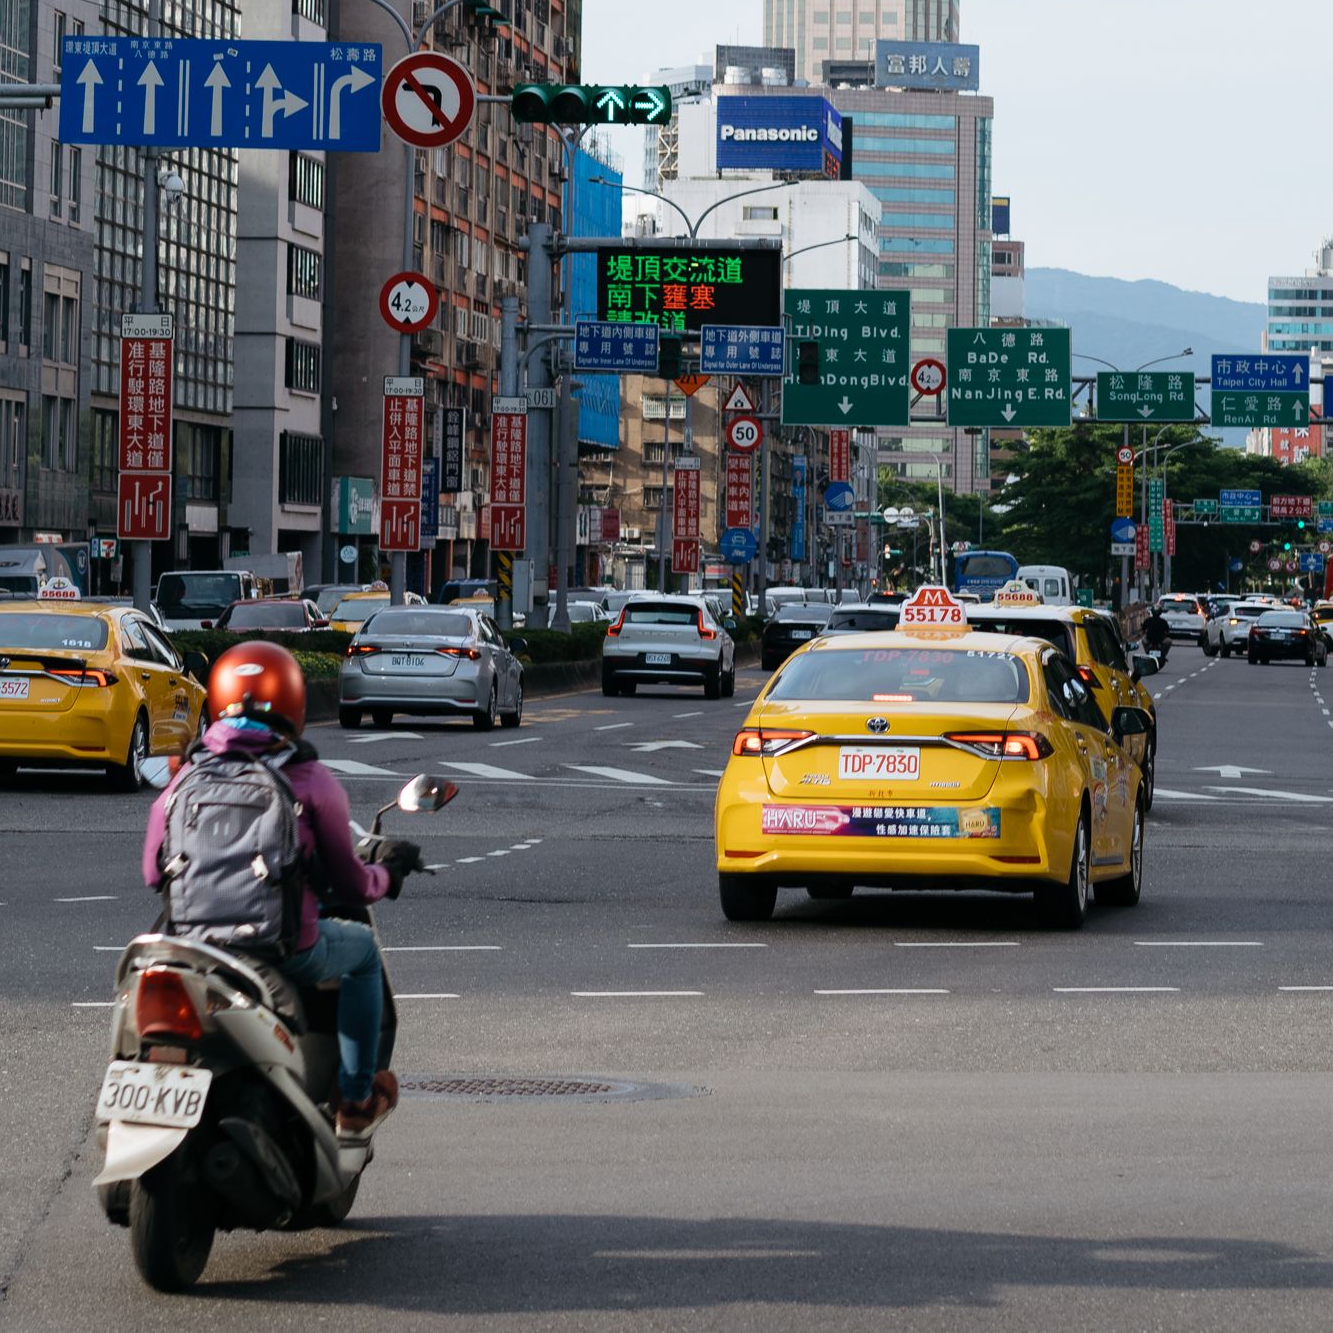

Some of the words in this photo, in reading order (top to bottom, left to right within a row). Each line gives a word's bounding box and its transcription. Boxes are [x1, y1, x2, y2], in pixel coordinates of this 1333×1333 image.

[65, 40, 118, 56] 環東堤頂大道
[130, 40, 173, 50] 南京東路
[134, 49, 169, 59] 八德路
[329, 47, 376, 62] 松壽路
[886, 54, 971, 77] 富邦人壽
[720, 124, 818, 142] Panasonic
[606, 254, 743, 284] 堤頂交流道
[391, 291, 412, 312] 4.2
[607, 283, 716, 310] 南下壅塞
[796, 299, 897, 315] 堤頂大道
[579, 325, 656, 340] 地下道內側車道
[705, 329, 782, 344] 地下道外側車道
[861, 326, 901, 339] Blvd.
[973, 332, 1044, 347] 八德路
[578, 341, 655, 356] 專用號誌
[705, 345, 781, 360] 專用號誌
[796, 347, 897, 364] 東大道
[967, 352, 1009, 364] BaDe
[1028, 352, 1050, 364] Rd.
[958, 368, 1059, 382] 南京東路
[1216, 359, 1287, 376] 市政中心
[1109, 375, 1183, 391] 松隆路
[1217, 377, 1244, 388] Taipei
[1248, 377, 1266, 388] City
[1270, 377, 1288, 387] Hall
[952, 388, 1023, 402] NanJing
[1028, 388, 1040, 400] E.
[1045, 388, 1066, 400] Rd.
[1109, 391, 1163, 403] SongLong
[1169, 391, 1186, 401] Rd.
[126, 341, 145, 468] 准行駛環東大道
[147, 341, 166, 468] 基隆路地下道僅
[1221, 395, 1283, 412] 仁愛路
[1224, 413, 1255, 423] RenAi
[735, 426, 755, 441] 50
[387, 398, 403, 496] 止併入平面車道
[403, 398, 418, 496] 基隆路地下道禁
[905, 608, 962, 623] 55178
[842, 754, 918, 774] TDP-7830
[767, 810, 817, 828] HARU
[876, 824, 951, 836] 性感加速保險套
